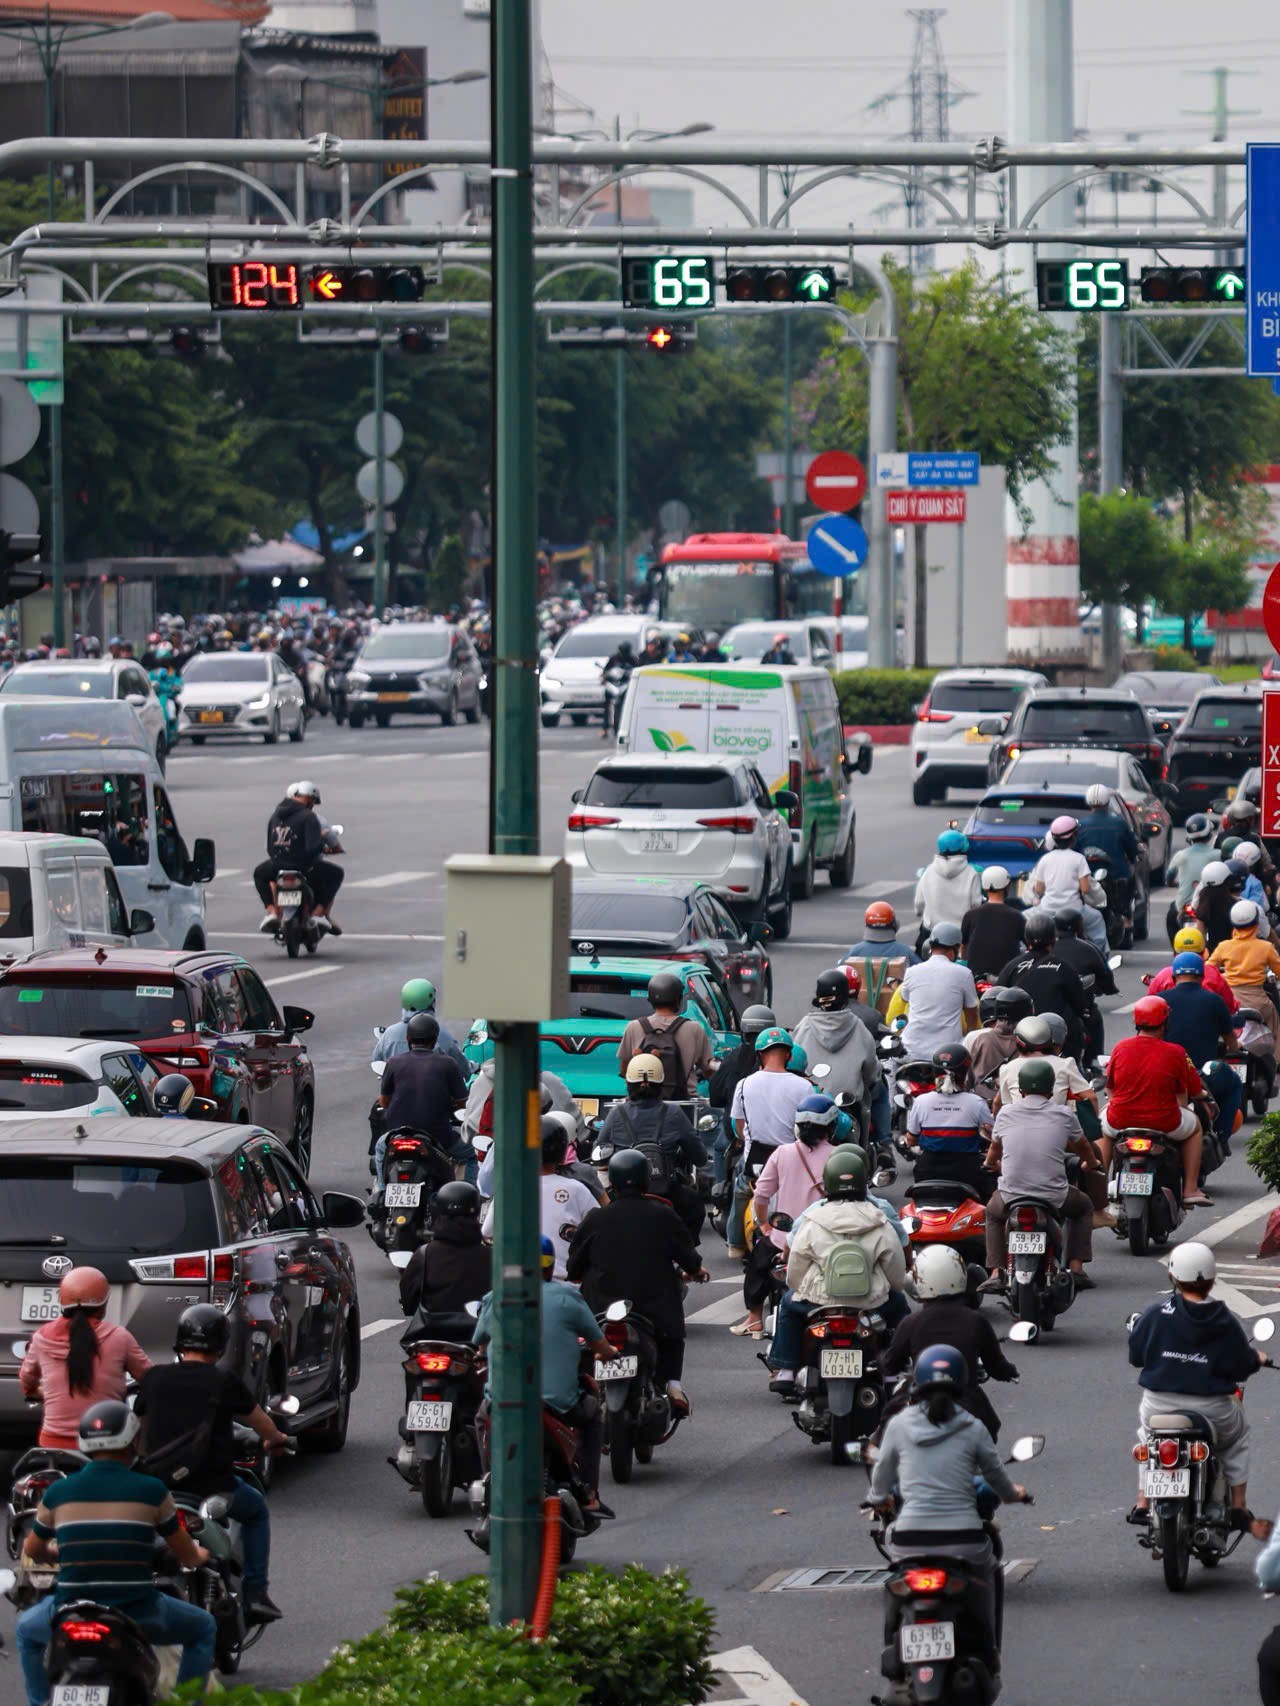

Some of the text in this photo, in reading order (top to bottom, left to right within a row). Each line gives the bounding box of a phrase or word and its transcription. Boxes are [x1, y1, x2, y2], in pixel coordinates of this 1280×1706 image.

[232, 262, 298, 307] 124
[654, 258, 710, 306] 65
[1068, 262, 1125, 308] 65
[889, 495, 965, 517] CHÚ Ý QUAN SÁT
[1015, 1234, 1041, 1243] 59-P3
[29, 1305, 59, 1319] 806
[828, 1352, 856, 1364] 77-H1
[824, 1364, 861, 1375] 403.46
[415, 1403, 444, 1415] 76-G1
[409, 1416, 448, 1429] 459.40
[1152, 1473, 1184, 1483] 62-AU
[1148, 1484, 1187, 1496] 007.94
[910, 1626, 947, 1643] 63-B5
[905, 1642, 952, 1660] 573.79
[63, 1689, 100, 1702] 60-H5
